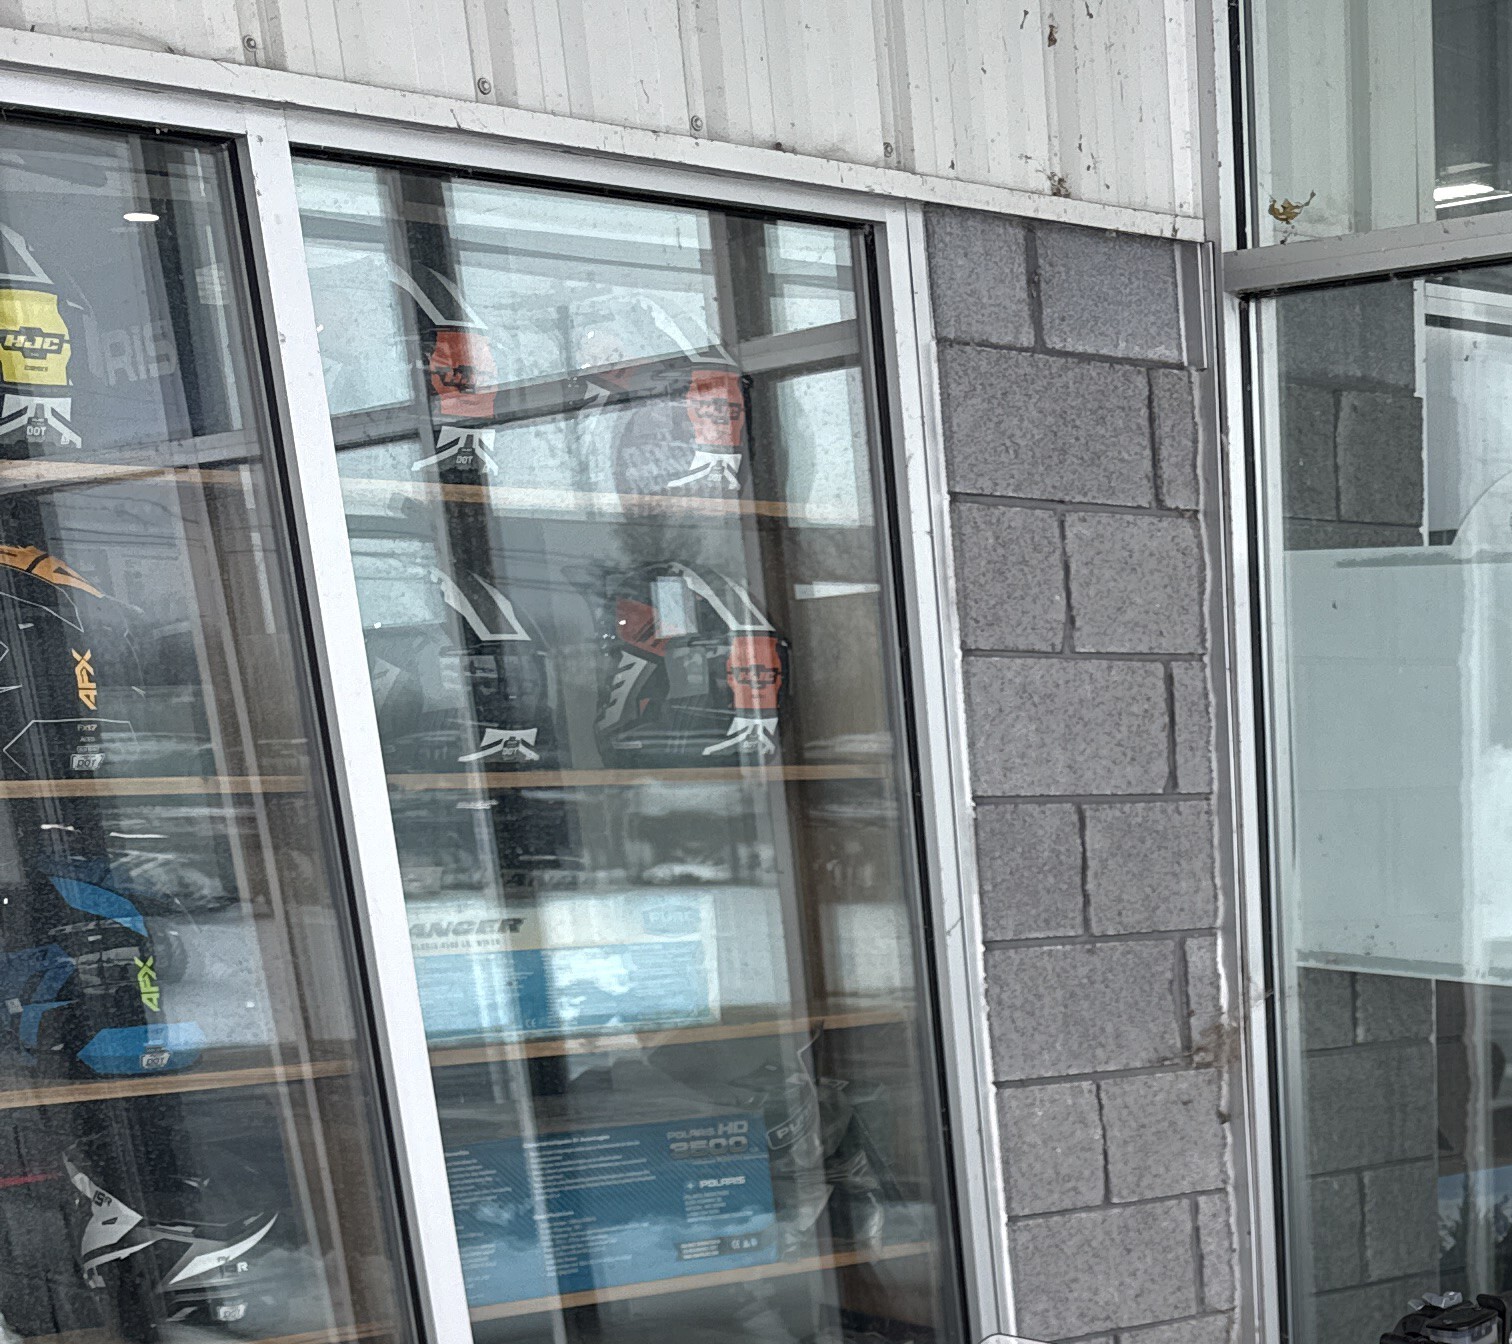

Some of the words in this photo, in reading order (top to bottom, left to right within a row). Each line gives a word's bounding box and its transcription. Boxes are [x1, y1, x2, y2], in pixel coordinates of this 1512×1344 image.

[4, 333, 61, 350] HJC
[71, 648, 98, 710] AFX
[408, 917, 527, 939] ANGER
[133, 955, 161, 1012] AFX
[717, 1120, 749, 1136] HD
[699, 1175, 747, 1189] POLARIS
